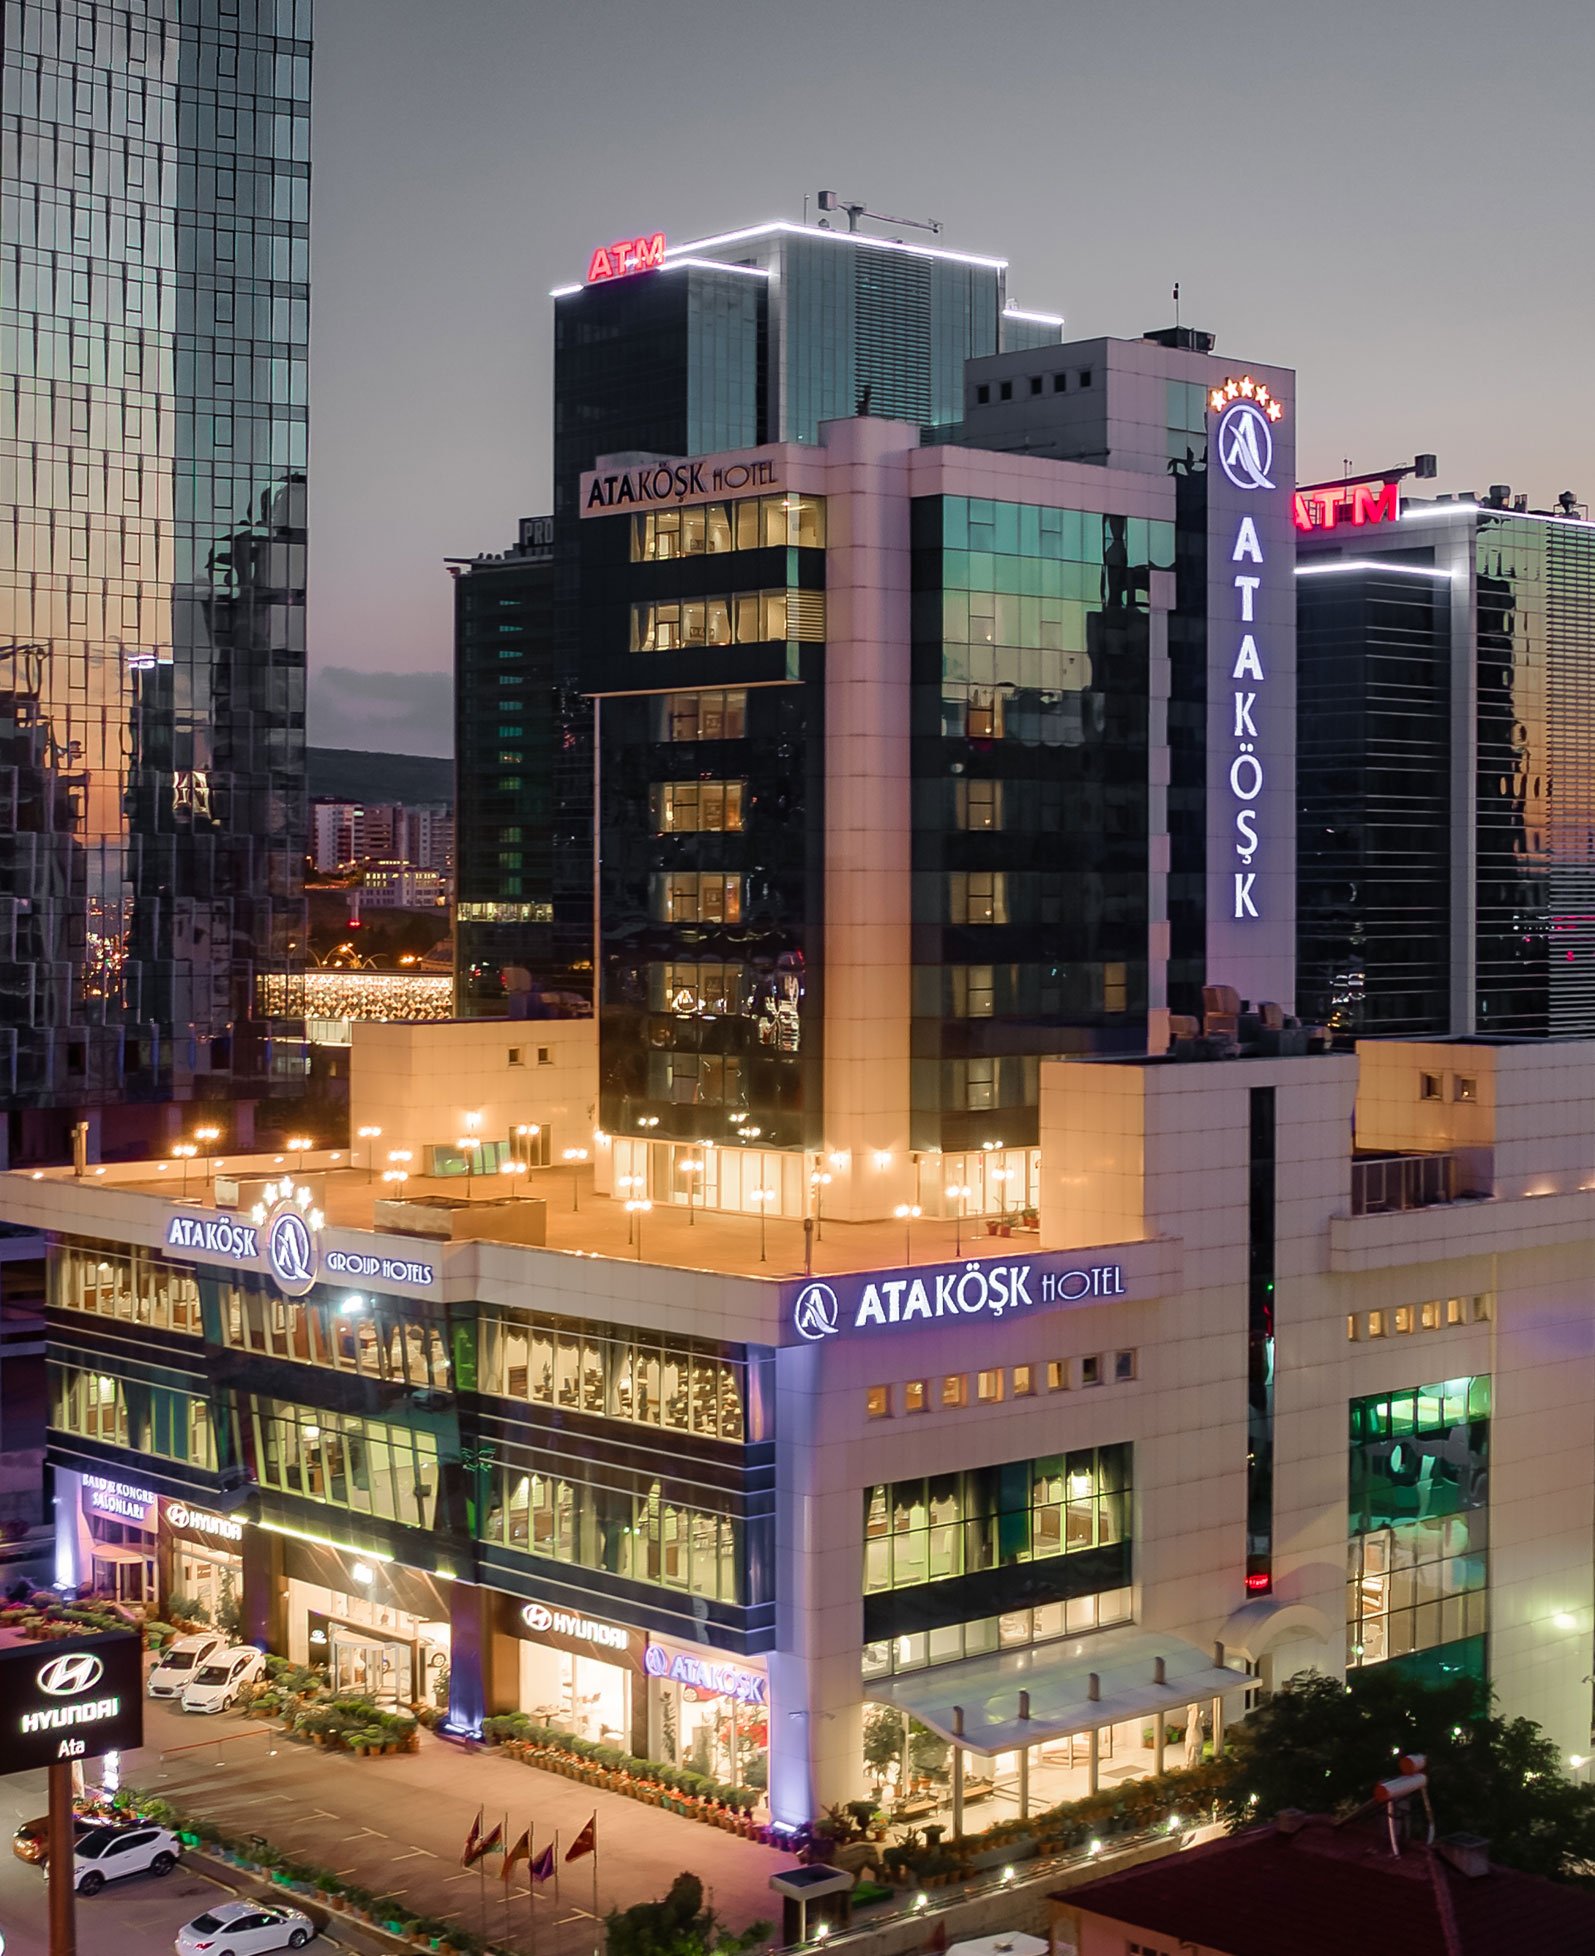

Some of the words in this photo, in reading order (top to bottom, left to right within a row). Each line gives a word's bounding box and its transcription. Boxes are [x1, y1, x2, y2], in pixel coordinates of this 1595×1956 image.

[588, 232, 665, 282] ATM
[587, 460, 708, 508] ATAKÖŞK
[712, 459, 779, 492] HOTEL
[1230, 517, 1264, 917] ATAKÖŞK
[169, 1217, 259, 1259] ATAKÖŞK
[327, 1251, 380, 1275] GROUP
[382, 1259, 433, 1285] HOTELS
[855, 1262, 1033, 1327] ATAKÖŞK
[1041, 1265, 1125, 1302] HOTEL
[553, 1612, 630, 1650] HYUNDAI
[21, 1698, 120, 1733] HYUNDAI
[58, 1738, 86, 1758] Ata
